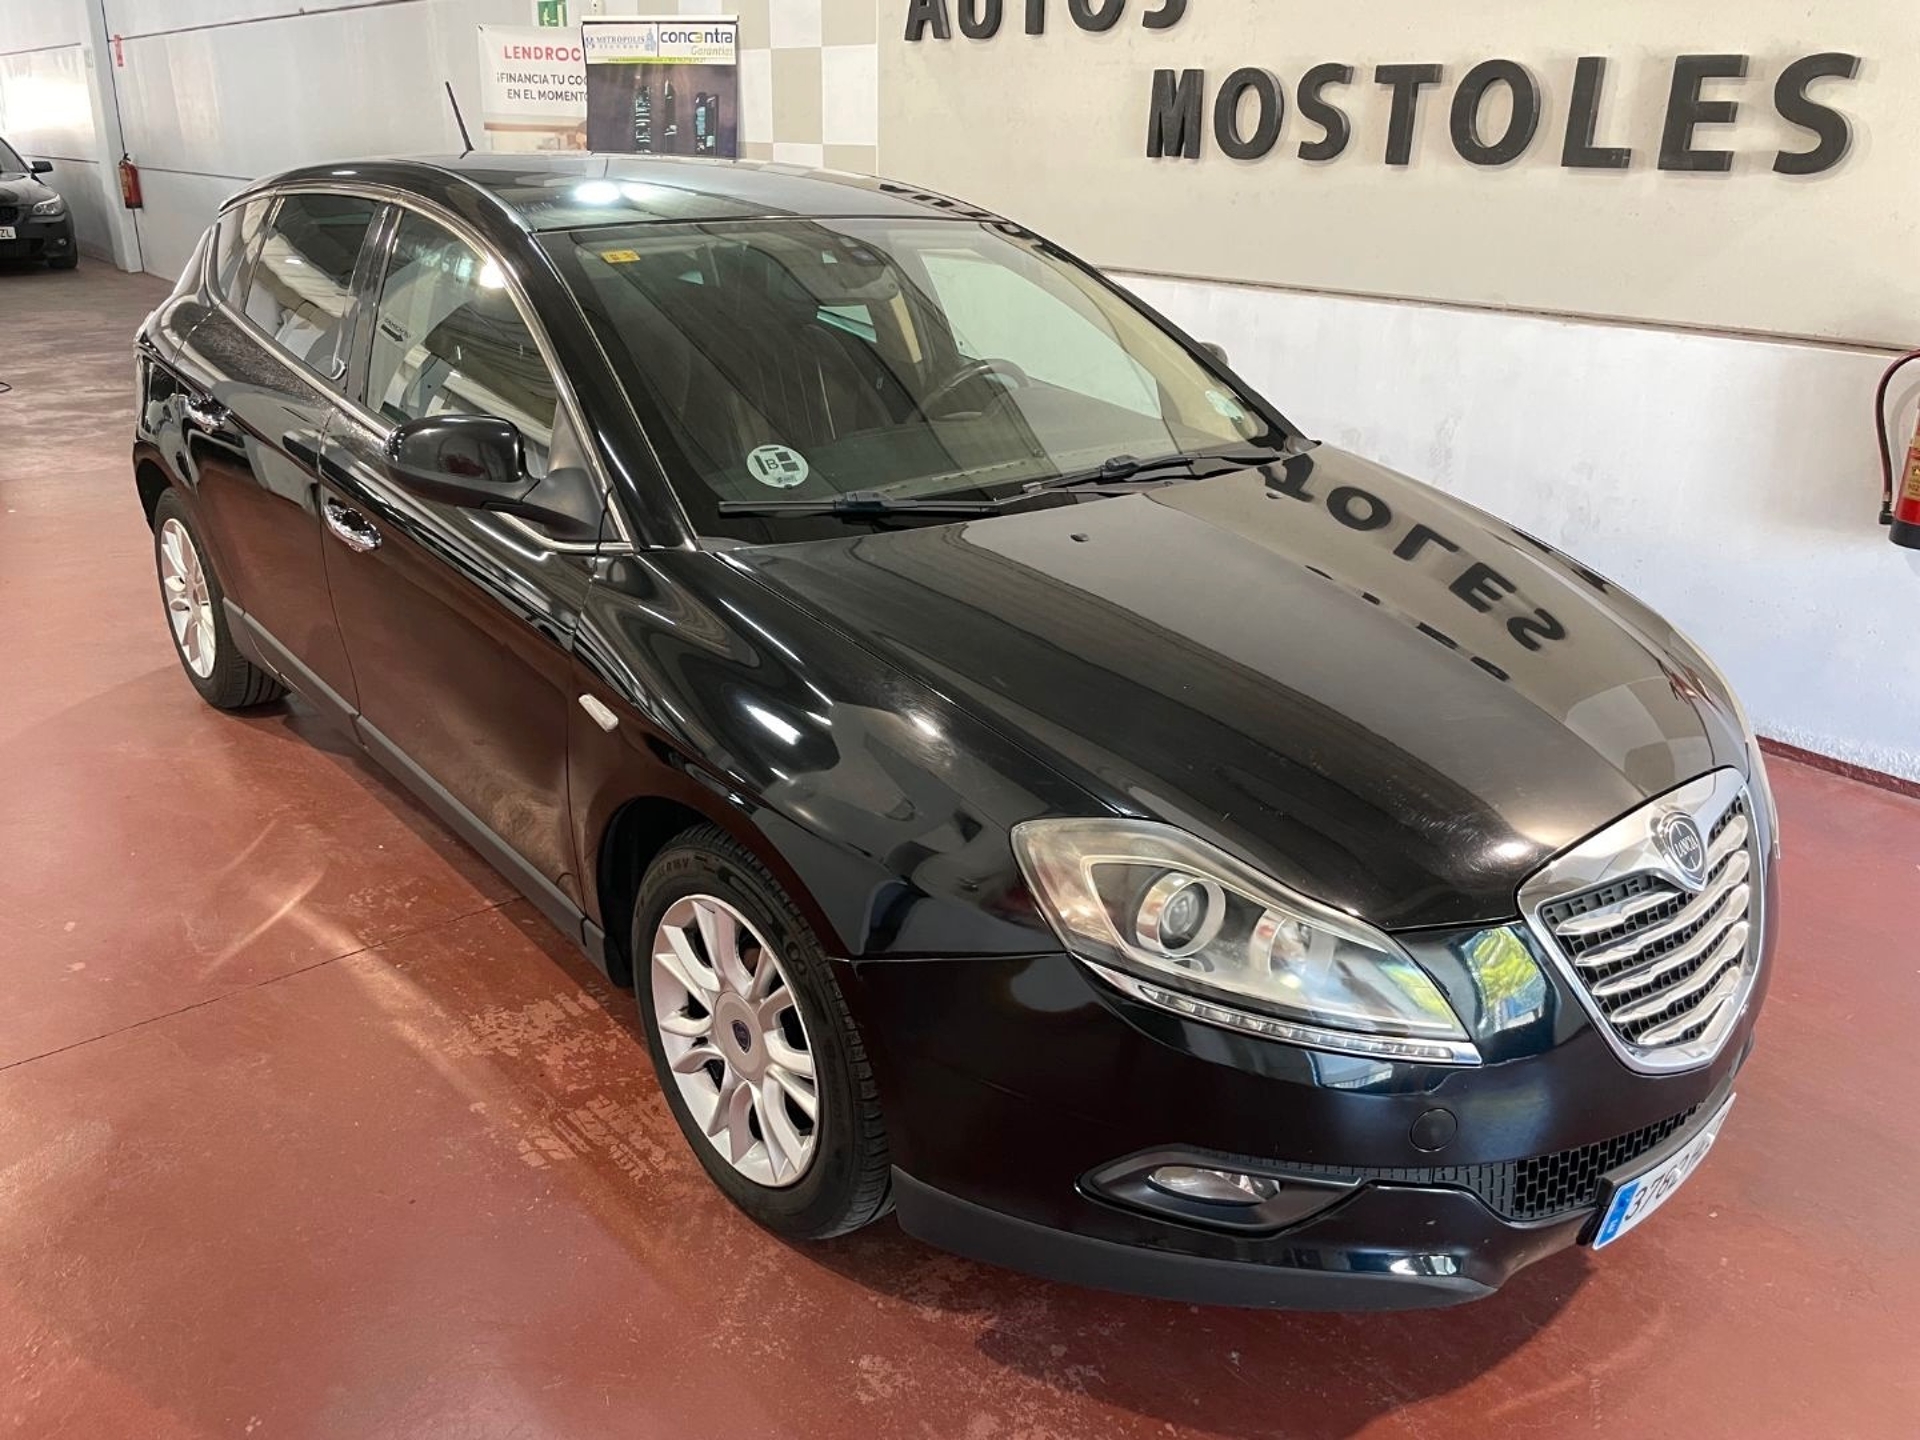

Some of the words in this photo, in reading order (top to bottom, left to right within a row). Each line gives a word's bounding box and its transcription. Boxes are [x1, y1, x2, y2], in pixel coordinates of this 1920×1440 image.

[551, 75, 565, 85] TU
[507, 88, 521, 100] EN
[523, 89, 537, 101] EL
[1146, 52, 1861, 175] MOSTOLES
